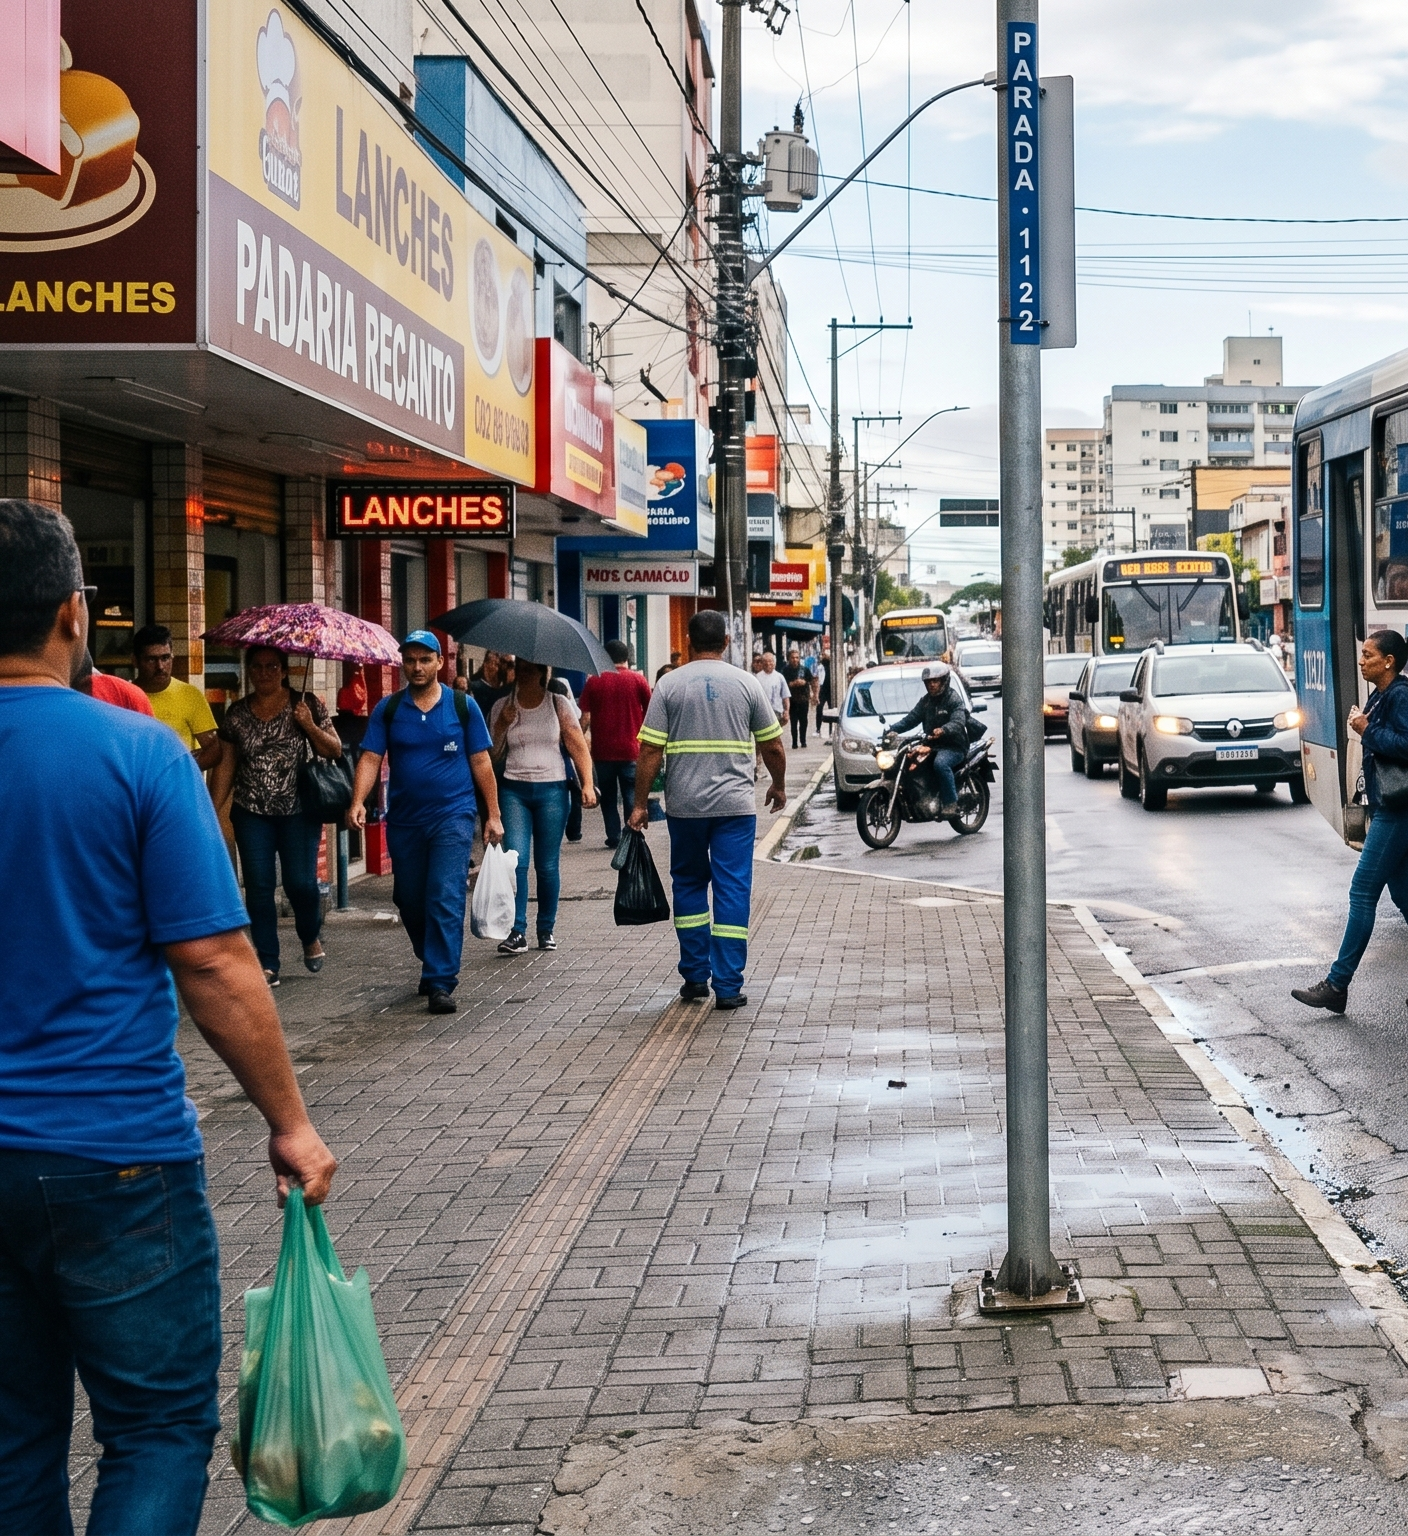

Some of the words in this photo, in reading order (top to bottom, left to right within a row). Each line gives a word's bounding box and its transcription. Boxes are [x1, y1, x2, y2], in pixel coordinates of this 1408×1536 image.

[1013, 32, 1034, 191] PARADA
[336, 105, 455, 302] LANCHES
[0, 281, 176, 314] ANCHES
[236, 219, 358, 385] PADARIA
[364, 302, 456, 431] RECANTO
[1019, 228, 1033, 331] 1122
[343, 496, 503, 525] LANCHES
